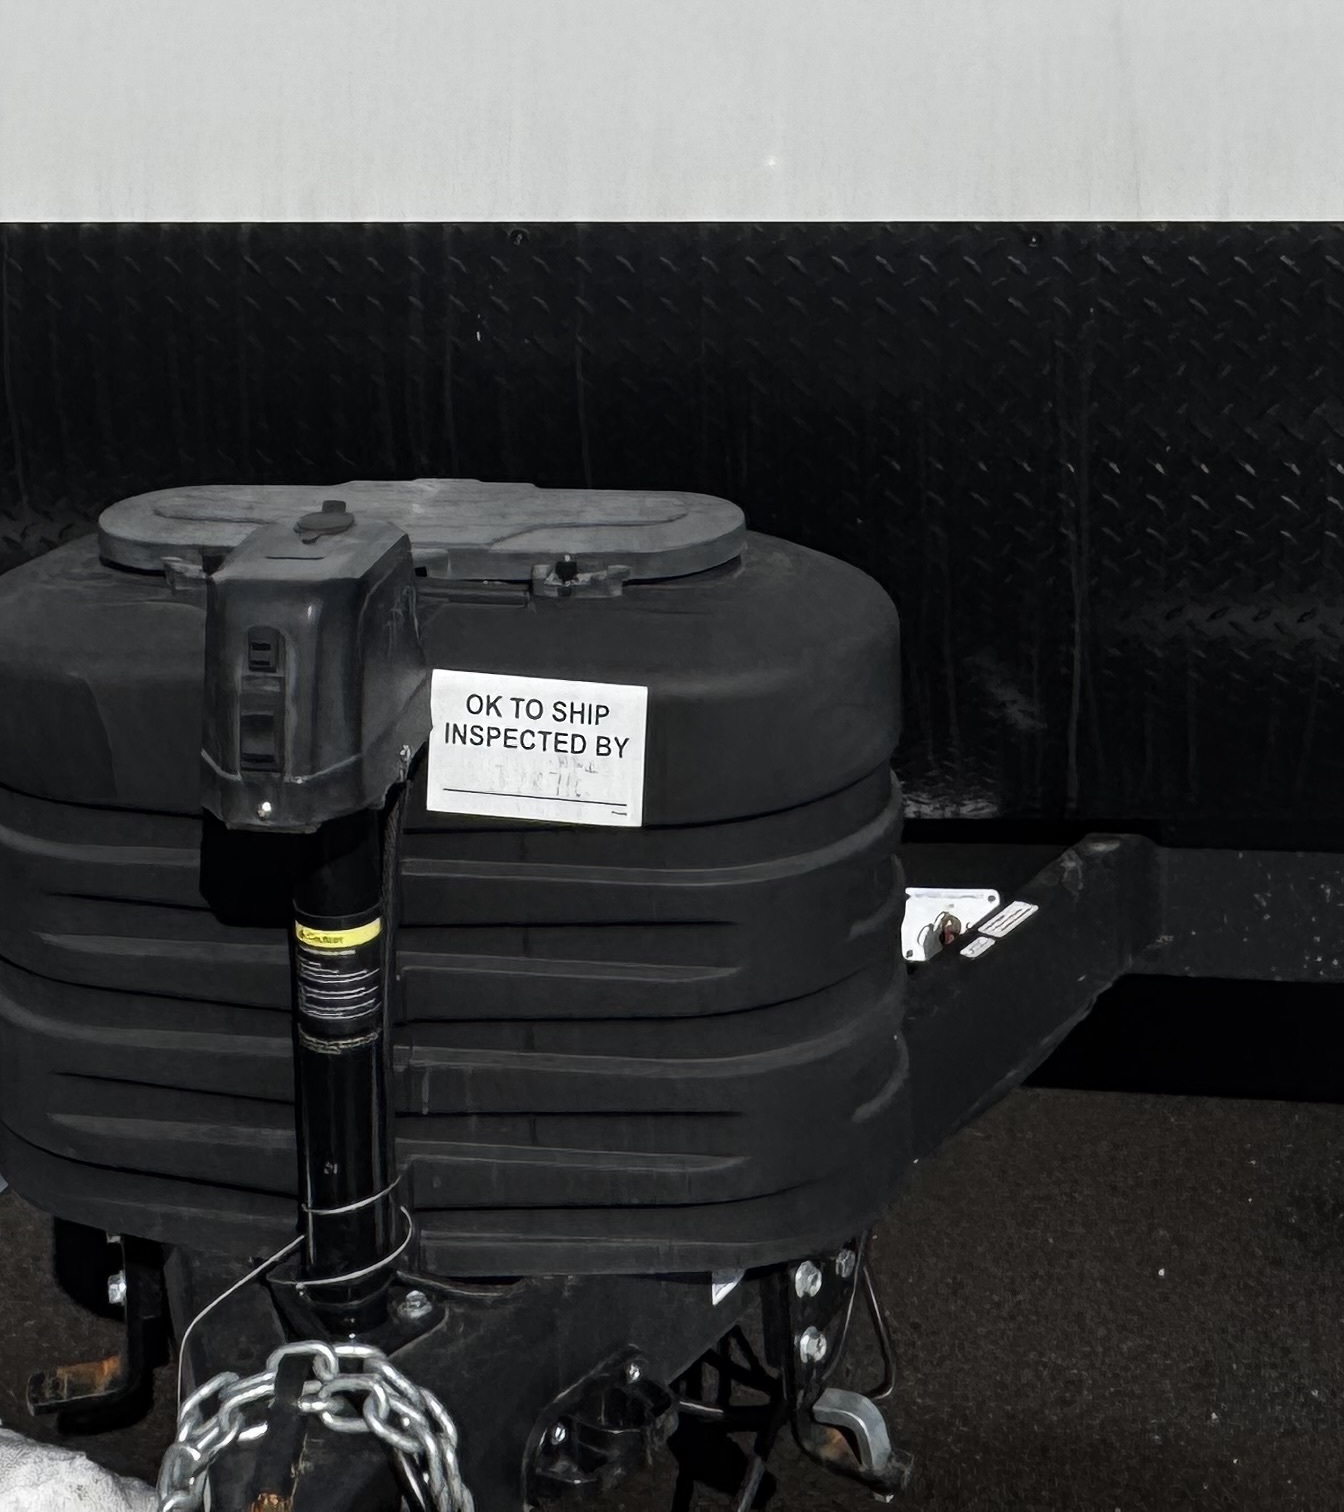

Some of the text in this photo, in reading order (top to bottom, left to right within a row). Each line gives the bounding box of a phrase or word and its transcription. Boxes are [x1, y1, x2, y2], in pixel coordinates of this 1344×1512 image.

[466, 693, 610, 726] OK TO SHIP
[444, 722, 630, 759] INSPECTED BY
